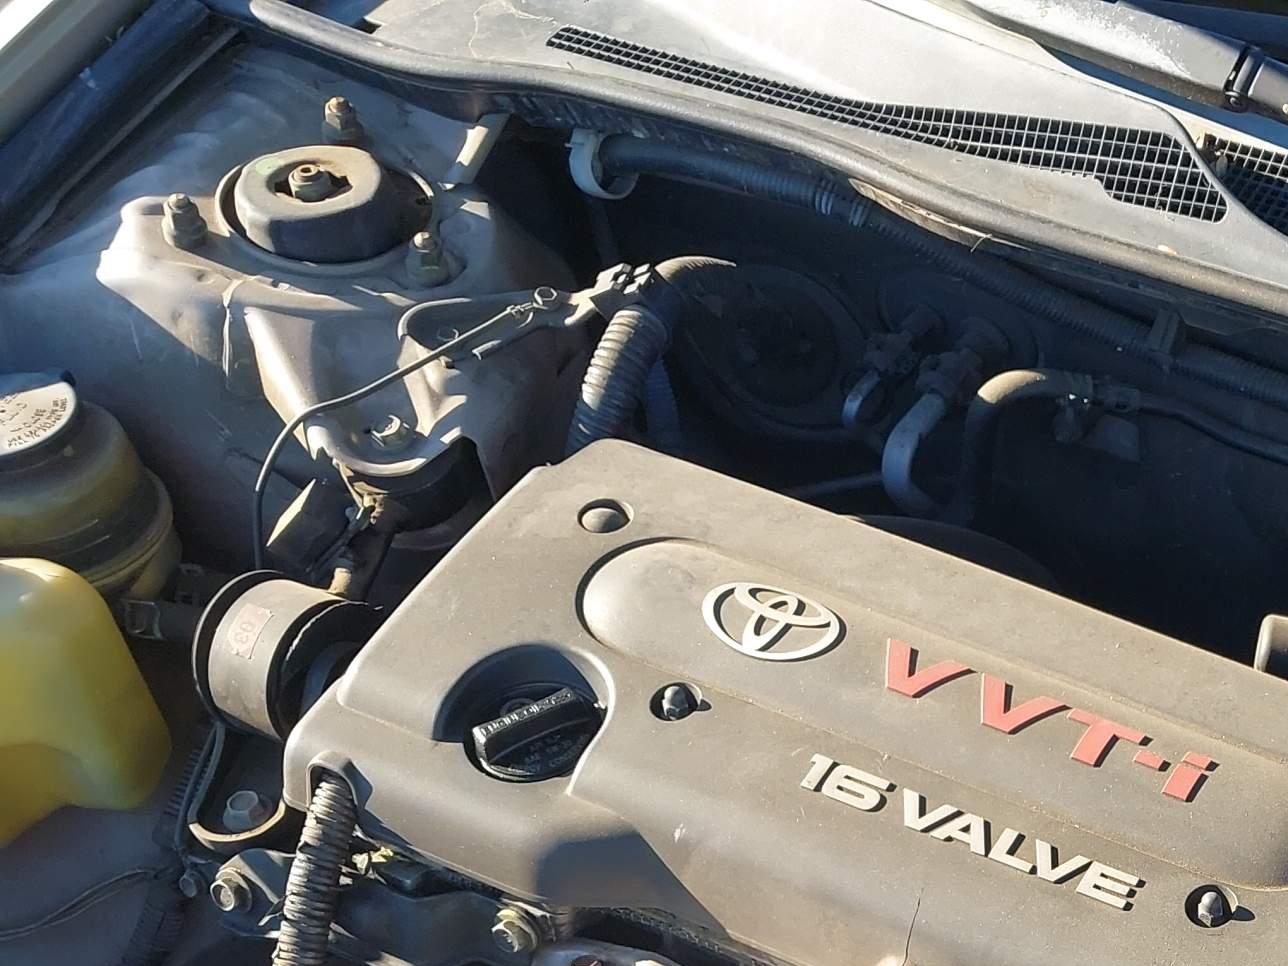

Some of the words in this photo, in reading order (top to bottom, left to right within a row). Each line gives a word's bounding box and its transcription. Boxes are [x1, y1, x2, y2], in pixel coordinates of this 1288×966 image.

[883, 637, 1219, 804] VVT-i
[800, 753, 895, 813] 16
[900, 787, 1144, 911] VALVE
